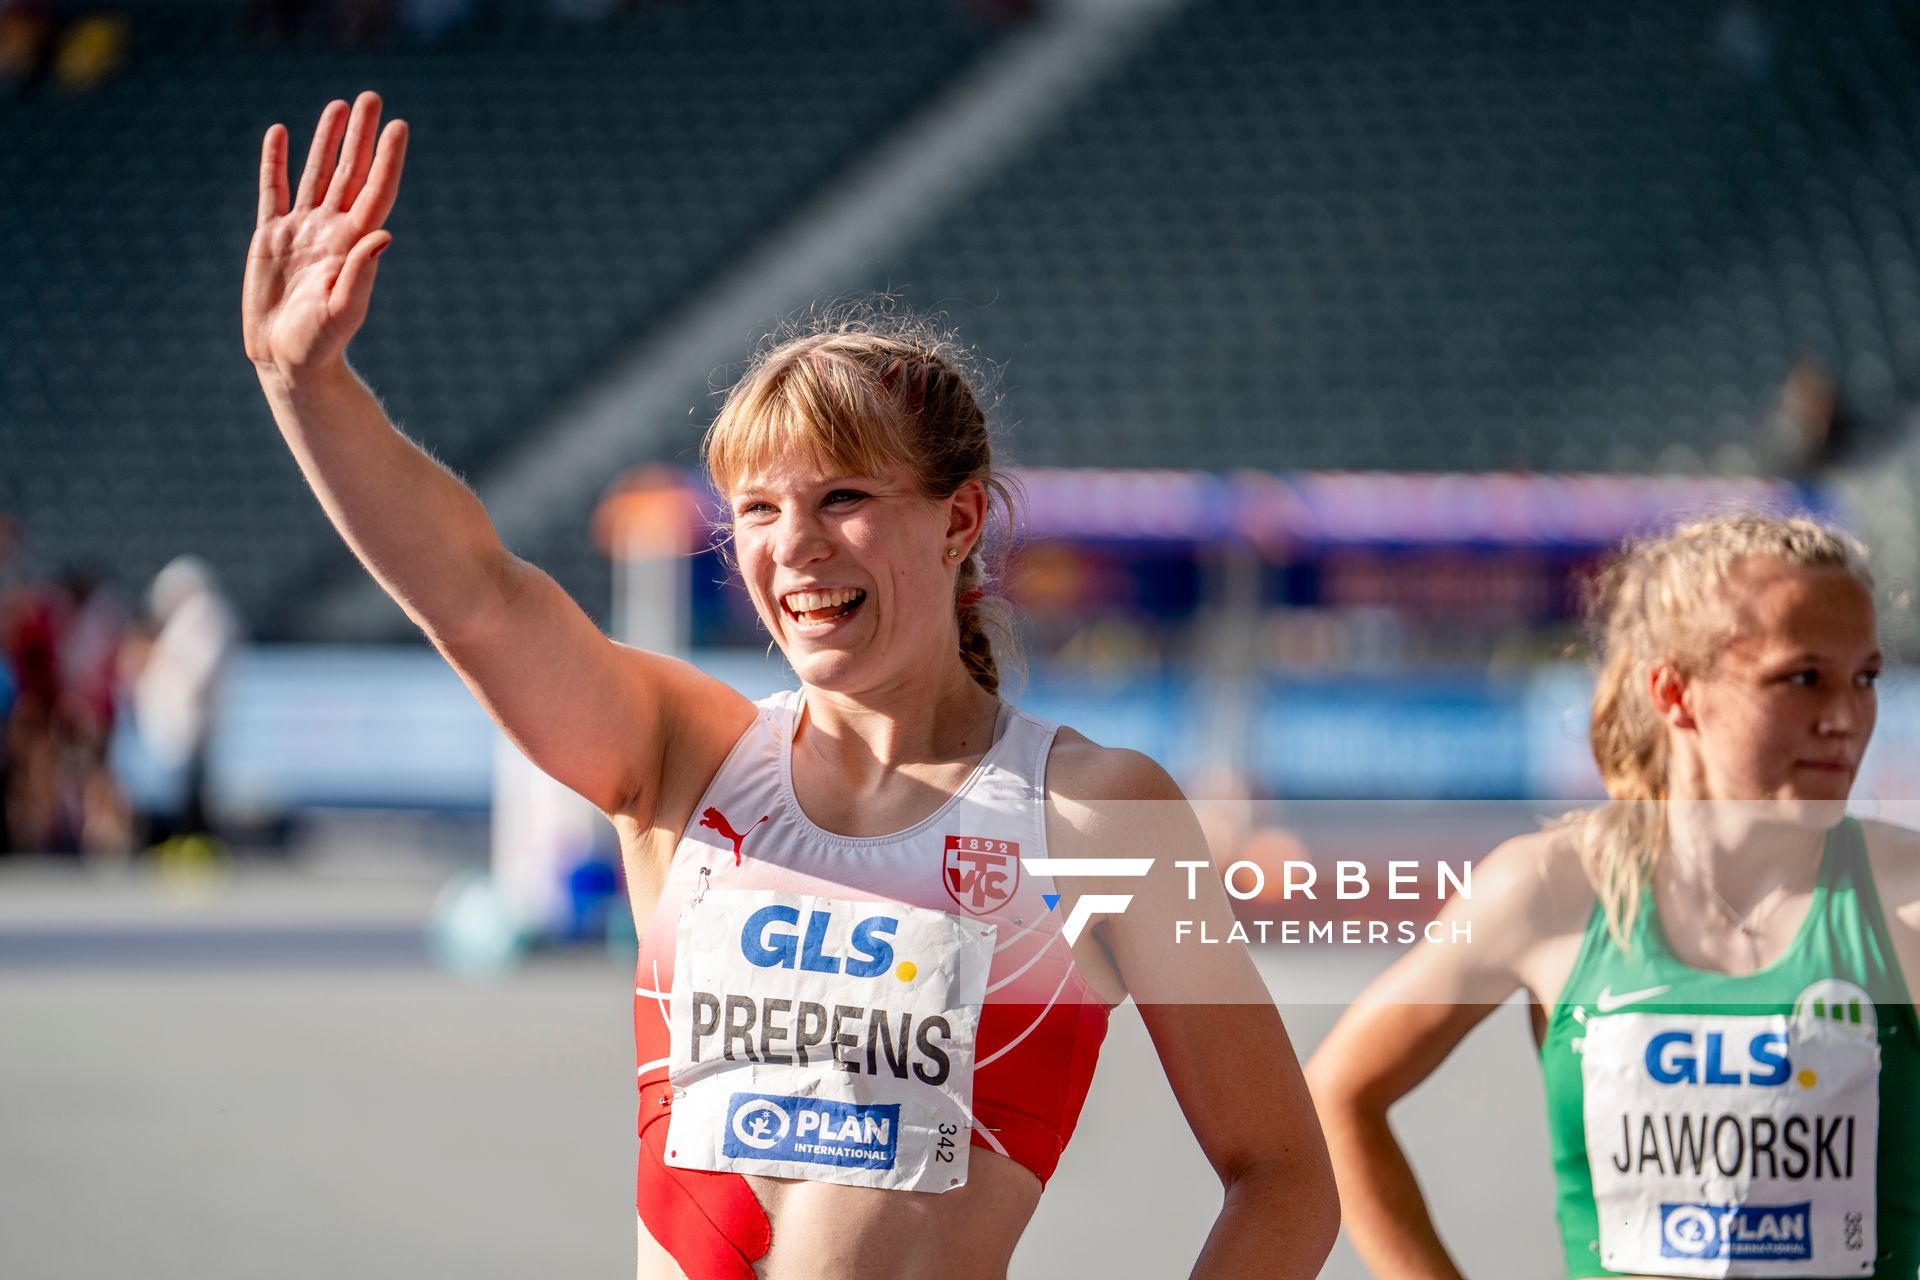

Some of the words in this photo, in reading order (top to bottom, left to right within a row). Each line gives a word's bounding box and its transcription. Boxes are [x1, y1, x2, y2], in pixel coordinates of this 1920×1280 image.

[956, 839, 1008, 854] 1892
[691, 991, 951, 1087] PREPENS
[796, 1110, 889, 1146] PLAN
[936, 1123, 958, 1164] 342
[1613, 1113, 1856, 1179] JAWORSKI
[794, 1143, 887, 1161] INTERNATIONAL
